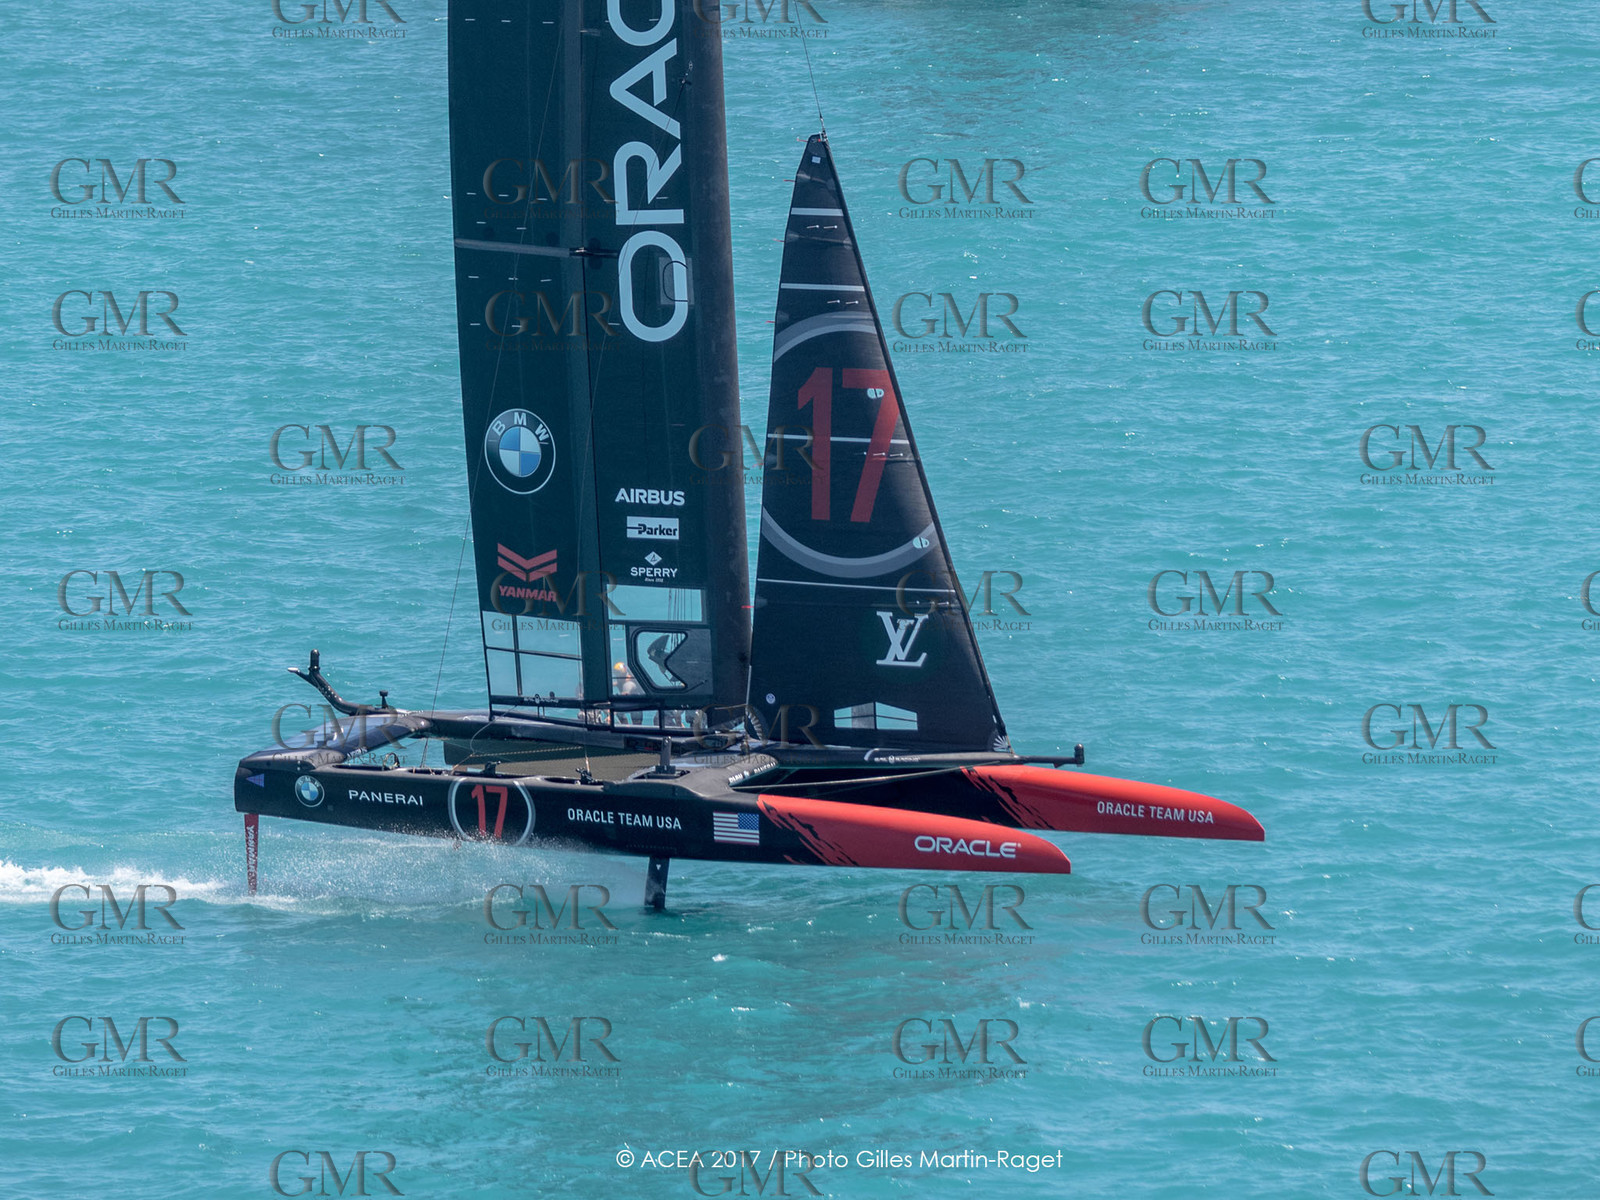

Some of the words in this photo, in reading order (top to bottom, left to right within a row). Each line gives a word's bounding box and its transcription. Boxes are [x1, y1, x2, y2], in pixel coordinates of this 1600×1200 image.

[797, 366, 900, 523] 17
[614, 487, 686, 507] AIRBUS
[637, 523, 678, 537] Parker
[630, 566, 678, 578] SPERRY
[498, 584, 557, 602] YANMAR
[348, 789, 424, 806] PANERAI
[470, 784, 508, 838] 17
[567, 807, 614, 824] ORACLE
[617, 811, 653, 827] TEAM
[656, 815, 682, 830] USA
[1096, 800, 1145, 818] ORACLE
[1149, 805, 1184, 821] TEAM
[1188, 809, 1214, 824] USA
